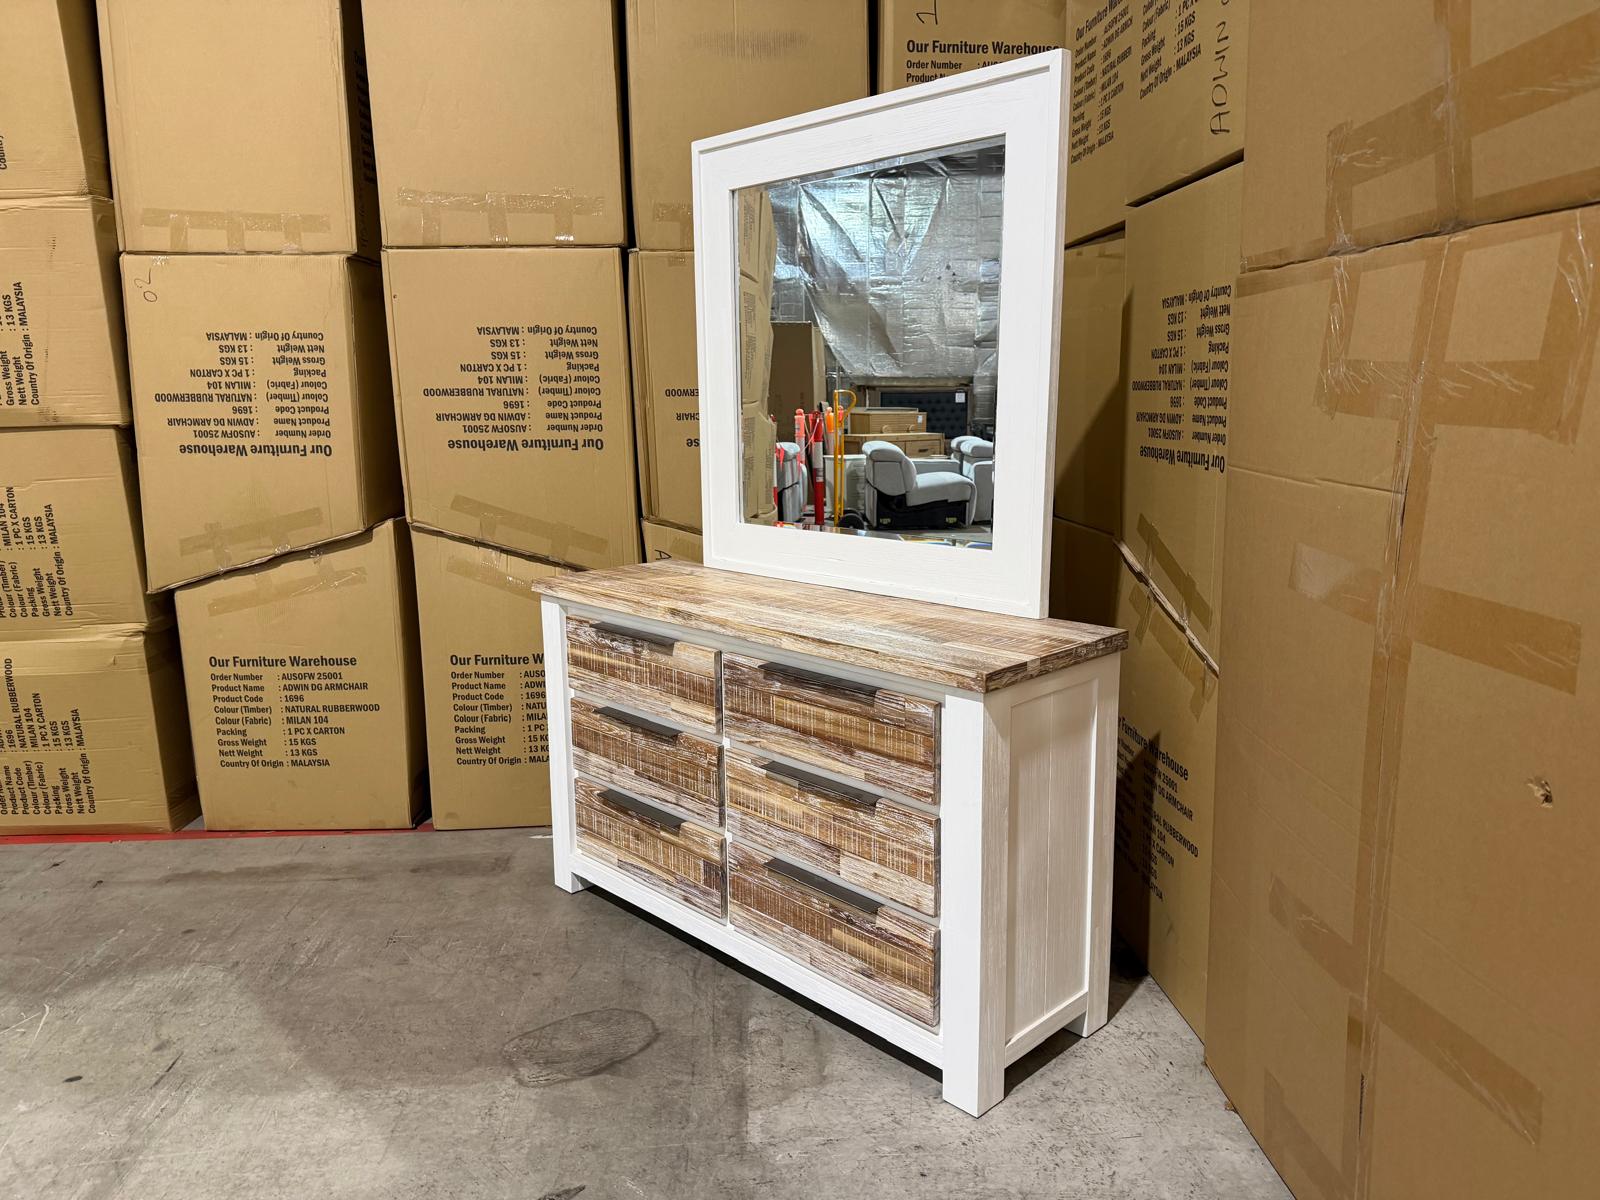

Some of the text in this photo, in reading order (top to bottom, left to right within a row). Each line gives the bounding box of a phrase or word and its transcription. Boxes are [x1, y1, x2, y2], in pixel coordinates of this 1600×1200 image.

[906, 40, 929, 53] Our
[932, 40, 988, 54] Furniture
[1176, 44, 1201, 71] MALAYSIA
[906, 60, 962, 70] Order Number
[1210, 21, 1231, 135] ADWIN
[206, 330, 324, 341] Country Of Origin MALAYSIA
[476, 324, 598, 336] Country Of Origin MALAYSIA
[13, 282, 40, 406] Country Of Origin MALAYSIA
[489, 337, 598, 348] Nett Weight 13 KGS
[2, 294, 28, 406] Nett Weight 13 KGS
[219, 355, 326, 366] Gross Weight 15 KGS
[207, 379, 328, 390] Colour (Fabric) MILAN 104
[423, 386, 601, 397] Colour (Timber) NATURAL RUBBERWOOD
[154, 392, 328, 403] Colour (Timber) NATURAL RUBBERWOOD
[503, 400, 602, 409] Product Code 1696
[232, 406, 329, 415] Product Code 1696
[167, 418, 330, 427] Product Name ADWIN DG ARMCHAIR
[436, 412, 602, 422] Product Name ADWIN DG ARMCHAIR
[193, 430, 331, 438] Order Number AUSOFW 25001
[462, 424, 603, 433] Order Number AUSOFW 25001
[179, 444, 332, 457] Our Furniture Warehouse
[448, 438, 604, 452] Our Furniture Warehouse
[1139, 445, 1225, 474] Our Furniture Warehouse
[44, 504, 73, 616] Country Of Origin MALAYSIA
[33, 516, 62, 616] Nett Weight 13 KGS
[209, 655, 357, 668] Our Furniture Warehouse
[450, 654, 530, 666] Our Furniture
[210, 672, 343, 681] Order Number AUSOFW 25001
[211, 682, 368, 692] Product Name ADWIN DG ARMCHAIR
[212, 694, 305, 703] Product Code 1696
[452, 690, 546, 701] Product Code 1696
[214, 703, 380, 715] Colour (Timber) NATURAL RUBBERWOOD
[453, 703, 513, 712] Colour (Timber)
[4, 658, 40, 814] Colour (Timber) NATURAL RUBBERWOOD
[455, 734, 538, 746] Gross Weight 15
[456, 744, 539, 756] Nett Weight 13
[70, 708, 96, 814] Country Of Origin MALAYSIA
[220, 758, 330, 769] Country Of Origin MALAYSIA
[456, 756, 522, 766] Country Of Origin
[49, 721, 74, 815] Gross Weight 15 KGS
[60, 720, 85, 814] Nett Weight 13 KGS
